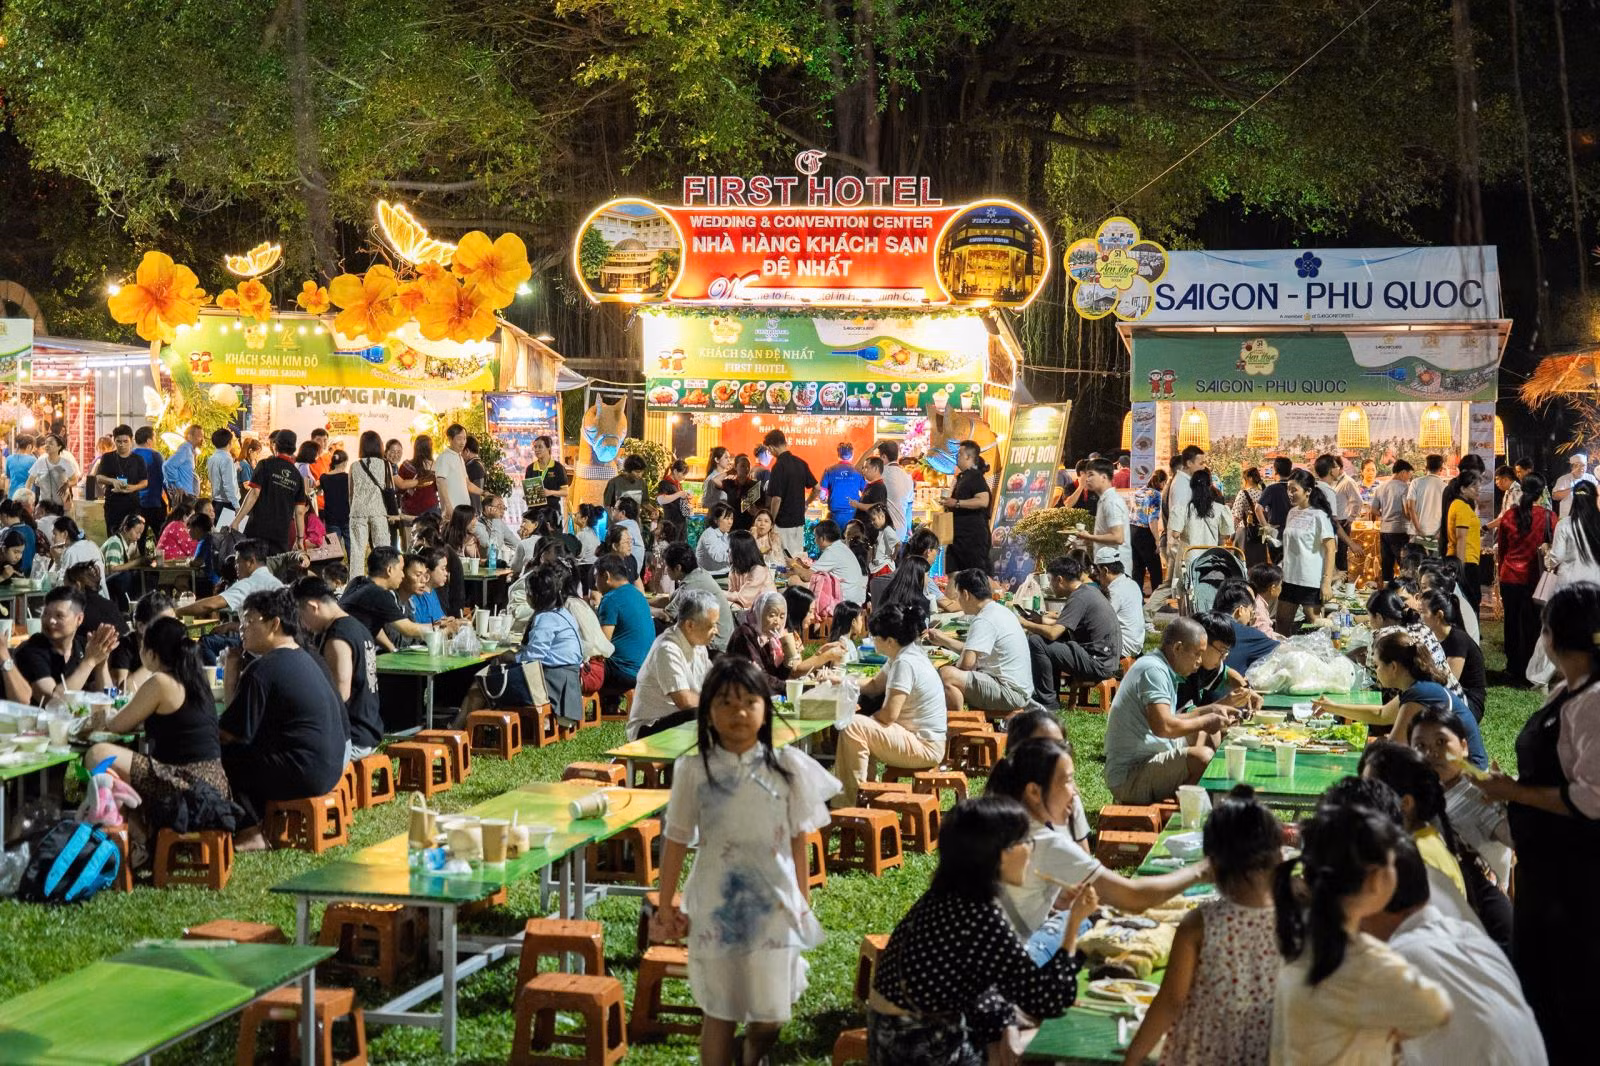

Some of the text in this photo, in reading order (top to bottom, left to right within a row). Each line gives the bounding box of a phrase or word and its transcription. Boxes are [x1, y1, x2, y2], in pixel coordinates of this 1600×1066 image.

[683, 175, 943, 208] FIRST HOTEL
[690, 215, 933, 229] WEDDING & CONVENTION CENTER
[692, 230, 929, 257] NHÀ HÀNG KHÁCH SẠN
[762, 253, 853, 280] ĐỆ NHẤT
[1155, 282, 1279, 311] SAIGON
[1306, 281, 1373, 310] PHU
[1383, 279, 1483, 311] QUOC
[224, 351, 319, 368] KHÁCH SẠN KIM ĐÔ
[700, 346, 815, 361] KHÁCH SẠN ĐỆ NHẤT
[258, 368, 279, 377] HOTEL
[281, 369, 307, 379] SAIGON
[724, 363, 787, 374] FIRST HOTEL
[1195, 378, 1254, 394] SAIGON
[1266, 378, 1298, 394] PHU
[1302, 378, 1348, 395] QUOC
[372, 389, 416, 410] NAM
[1010, 444, 1057, 467] THỰC ĐƠN
